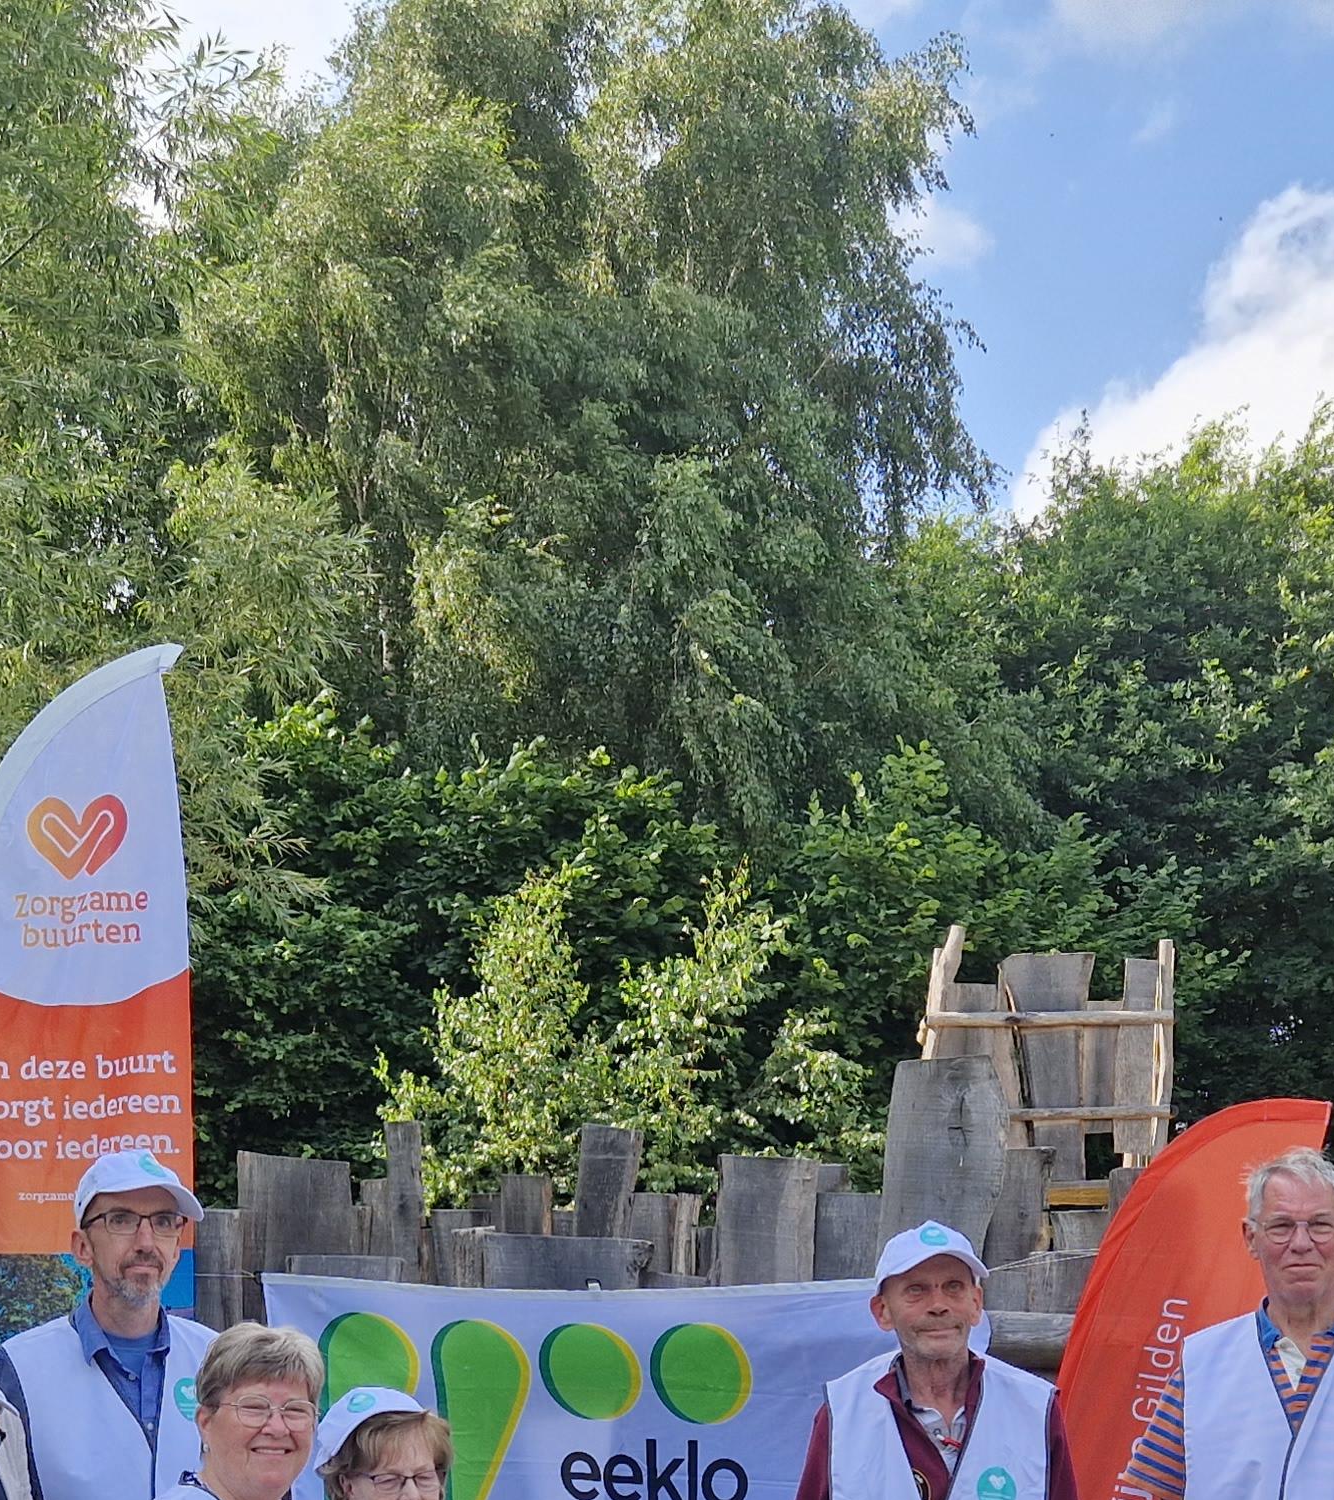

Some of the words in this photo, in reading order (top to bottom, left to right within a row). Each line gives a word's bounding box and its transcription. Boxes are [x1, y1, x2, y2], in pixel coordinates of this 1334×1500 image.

[23, 919, 141, 948] buurten
[20, 1055, 86, 1080] deze
[95, 1051, 176, 1080] buurt
[63, 1094, 181, 1120] iedereen
[56, 1134, 180, 1160] iedereen.
[18, 1190, 77, 1204] zorgzame
[1132, 1299, 1188, 1421] Gilden
